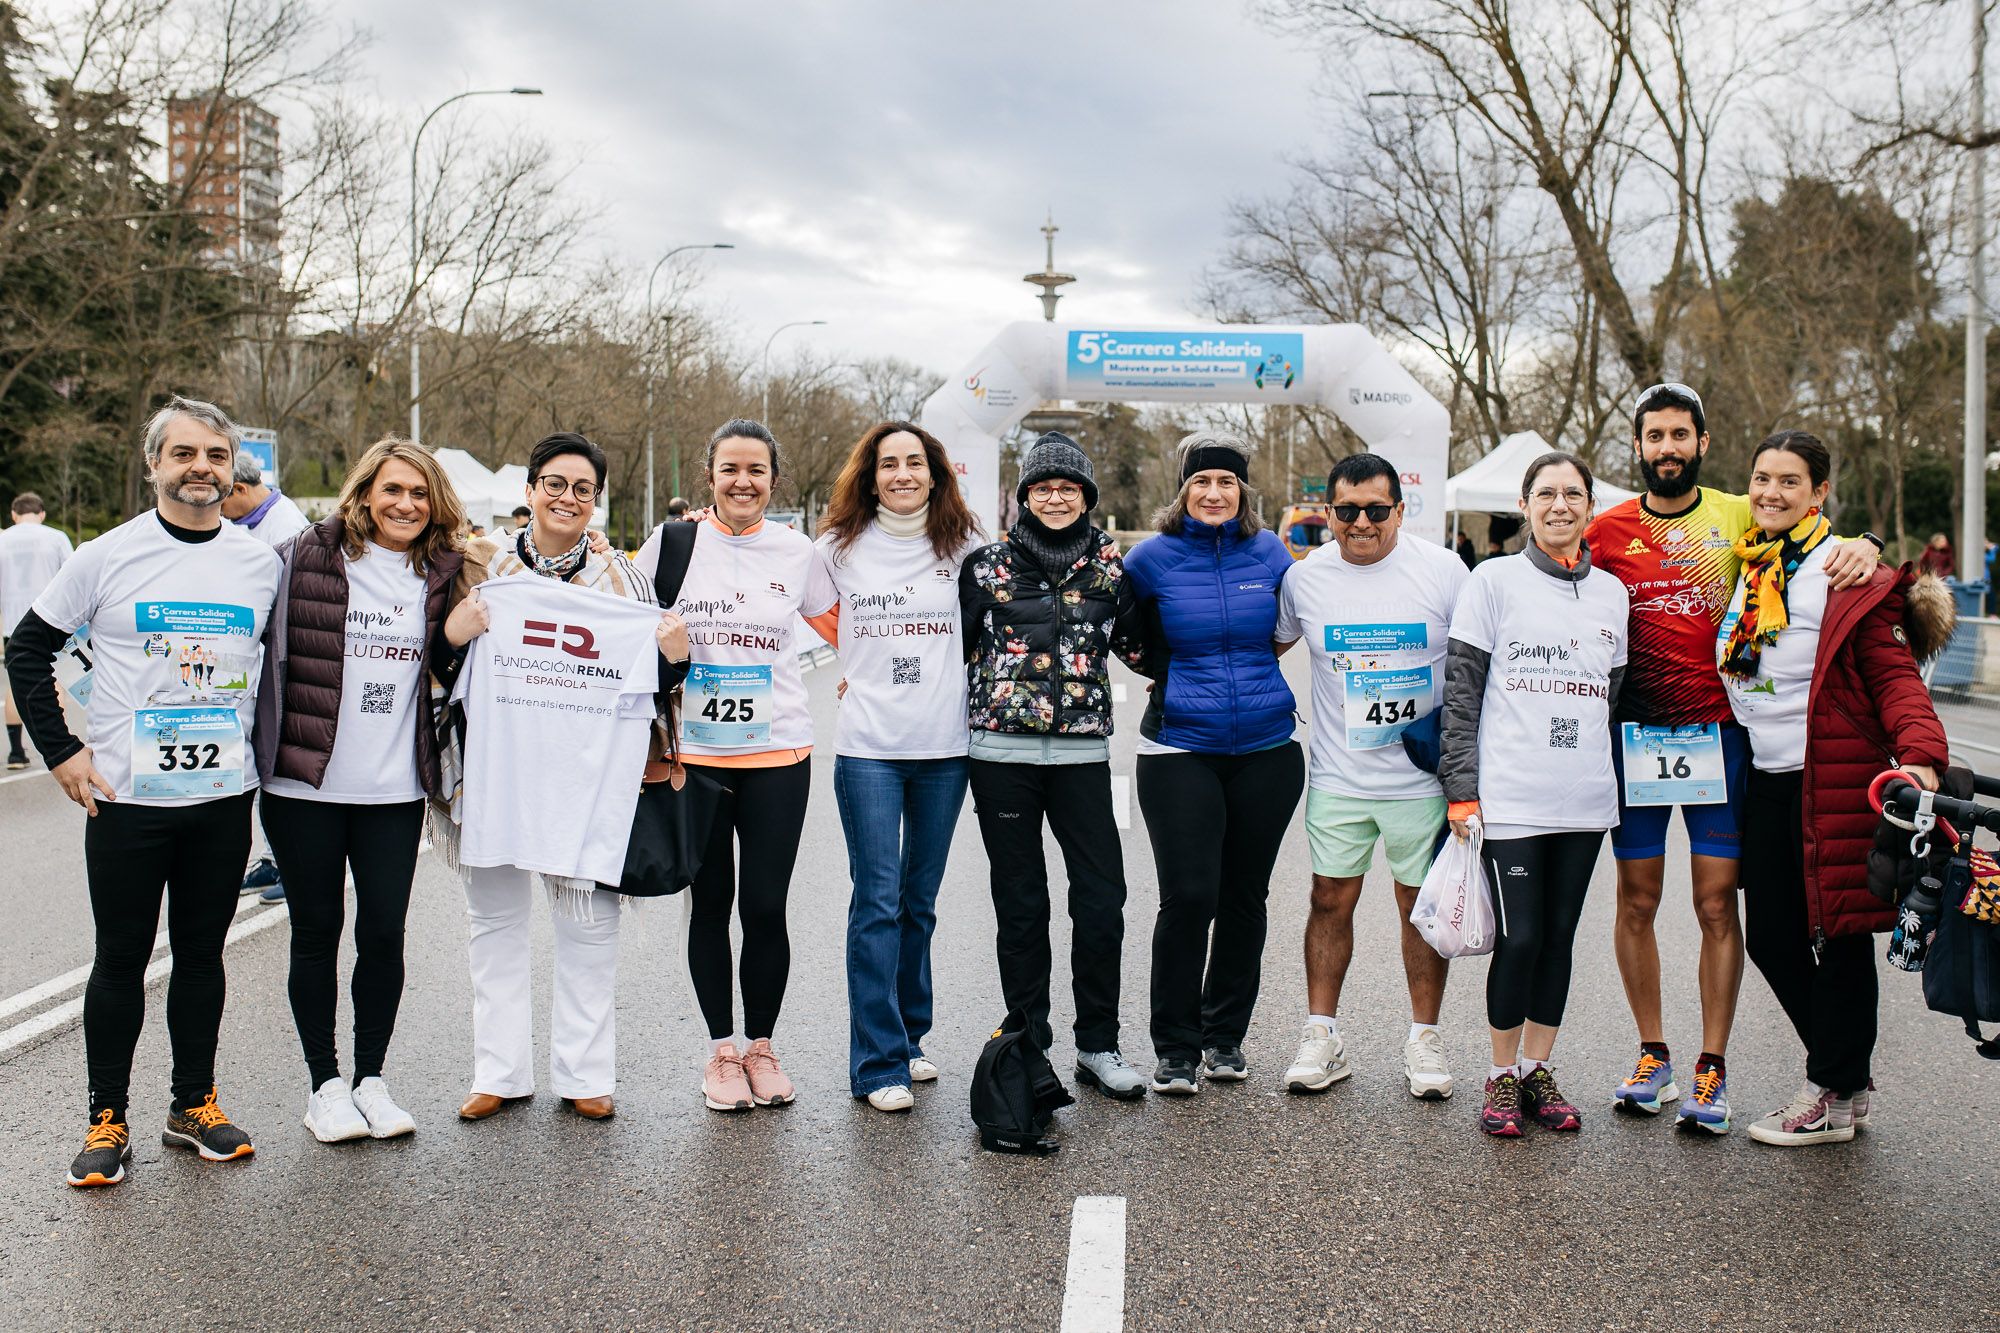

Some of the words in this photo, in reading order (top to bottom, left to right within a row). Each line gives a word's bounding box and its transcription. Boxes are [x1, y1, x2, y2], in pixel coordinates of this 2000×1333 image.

[1102, 339, 1175, 357] Carrera
[1180, 339, 1262, 358] Solidaria
[1153, 365, 1168, 374] por
[1171, 363, 1181, 373] la
[1184, 363, 1210, 373] Salud
[1213, 364, 1240, 374] Renal
[1363, 393, 1412, 404] MADRID
[954, 463, 968, 475] SL
[1400, 473, 1422, 485] CSL
[1671, 578, 1689, 587] TEAM
[677, 598, 736, 618] Siempre
[849, 592, 907, 611] Siempre
[162, 608, 197, 616] Carrera
[199, 608, 235, 618] Solidaria
[345, 610, 394, 630] mpre
[860, 613, 887, 622] puede
[889, 611, 915, 620] hacer
[916, 611, 936, 620] algo
[937, 611, 950, 619] por
[226, 625, 251, 637] 2026
[715, 620, 743, 630] hacer
[744, 621, 765, 632] algo
[766, 626, 781, 634] por
[1372, 629, 1406, 637] Solidaria
[346, 631, 368, 640] ede
[370, 632, 401, 642] hacer
[403, 635, 425, 646] algo
[687, 631, 781, 652] ALUDRENAL
[1397, 641, 1424, 651] 2026
[1507, 641, 1570, 665] Siempre
[704, 670, 730, 679] Carrera
[731, 671, 760, 679] Solidaria
[1519, 666, 1551, 675] puede
[1552, 666, 1577, 677] hacer
[526, 674, 588, 690] ESPAÑOLA
[1363, 676, 1390, 684] Carrera
[1391, 674, 1420, 683] Solidaria
[1505, 677, 1607, 700] SALUDRENA
[496, 694, 613, 717] saudrenalsiempre.org
[701, 698, 754, 722] 425
[1365, 698, 1417, 725] 434
[191, 714, 225, 722] Solidaria
[158, 743, 220, 772] 332
[1657, 755, 1692, 779] 16
